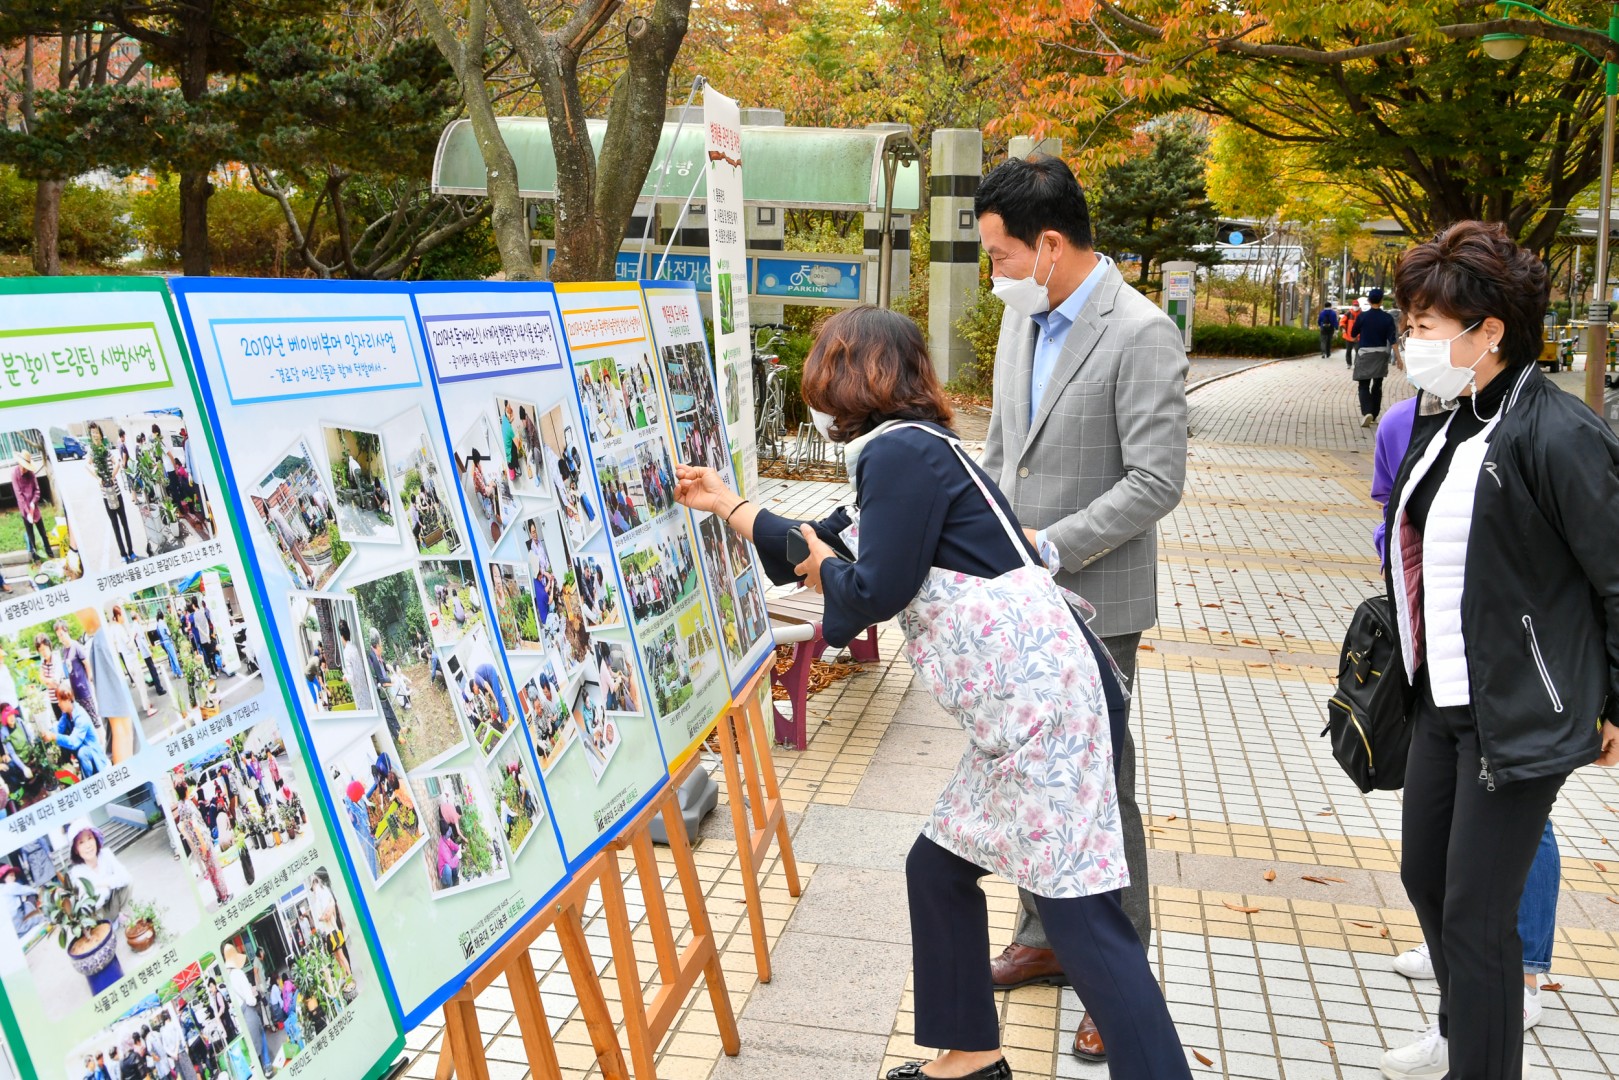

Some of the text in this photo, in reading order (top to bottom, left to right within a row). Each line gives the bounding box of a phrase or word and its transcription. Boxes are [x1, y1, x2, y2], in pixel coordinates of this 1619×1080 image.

[788, 285, 828, 293] PARKING
[240, 330, 396, 357] 2019년 베이비부머 일자리사업
[433, 328, 455, 346] 2019년
[454, 327, 483, 349] 독거어르신
[2, 342, 156, 386] 분갈이 드림팀 시범사업
[276, 362, 382, 384] 경로당 어르신들과 함께 텃밭에서
[97, 568, 142, 591] 공기정화식물을
[156, 555, 181, 574] 분갈이도
[182, 552, 195, 565] 하고
[4, 589, 70, 621] 설명중이신 강사님
[210, 716, 233, 736] 분갈이를
[234, 702, 260, 722] 기다립니다
[8, 766, 131, 834] 식물에 따라 분갈이 방법이 달라요
[226, 906, 238, 921] 주공
[238, 894, 255, 911] 아파트
[254, 880, 274, 898] 주민들이
[274, 868, 288, 888] 순서를
[308, 848, 318, 861] 모습
[489, 914, 508, 936] 도시농부
[94, 949, 178, 1014] 식물과 함께 행복한 주민
[290, 1052, 312, 1076] 어린이도
